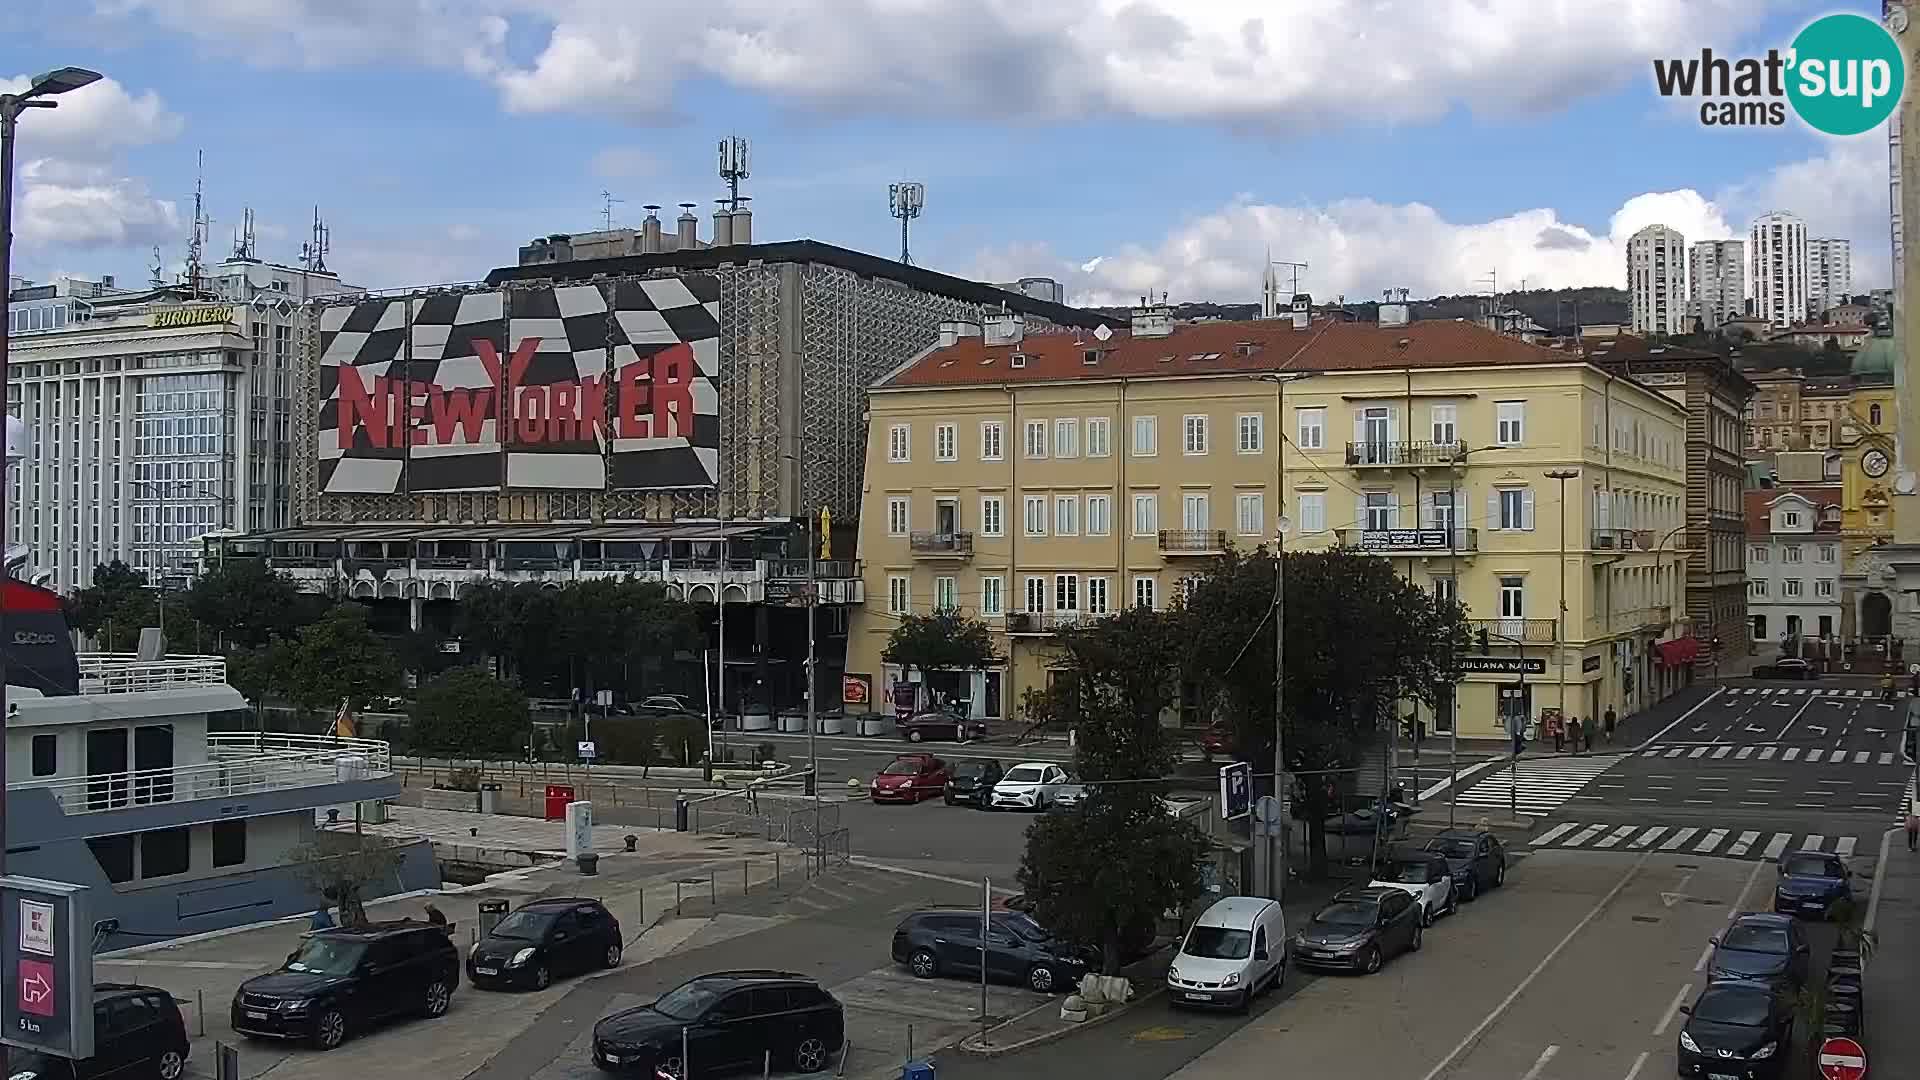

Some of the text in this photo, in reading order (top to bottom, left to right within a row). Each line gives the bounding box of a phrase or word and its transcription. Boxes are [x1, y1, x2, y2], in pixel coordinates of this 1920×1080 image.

[154, 306, 234, 327] EUROHERC
[1458, 662, 1541, 671] JULIANA NAILS
[20, 1018, 41, 1033] 5 km
